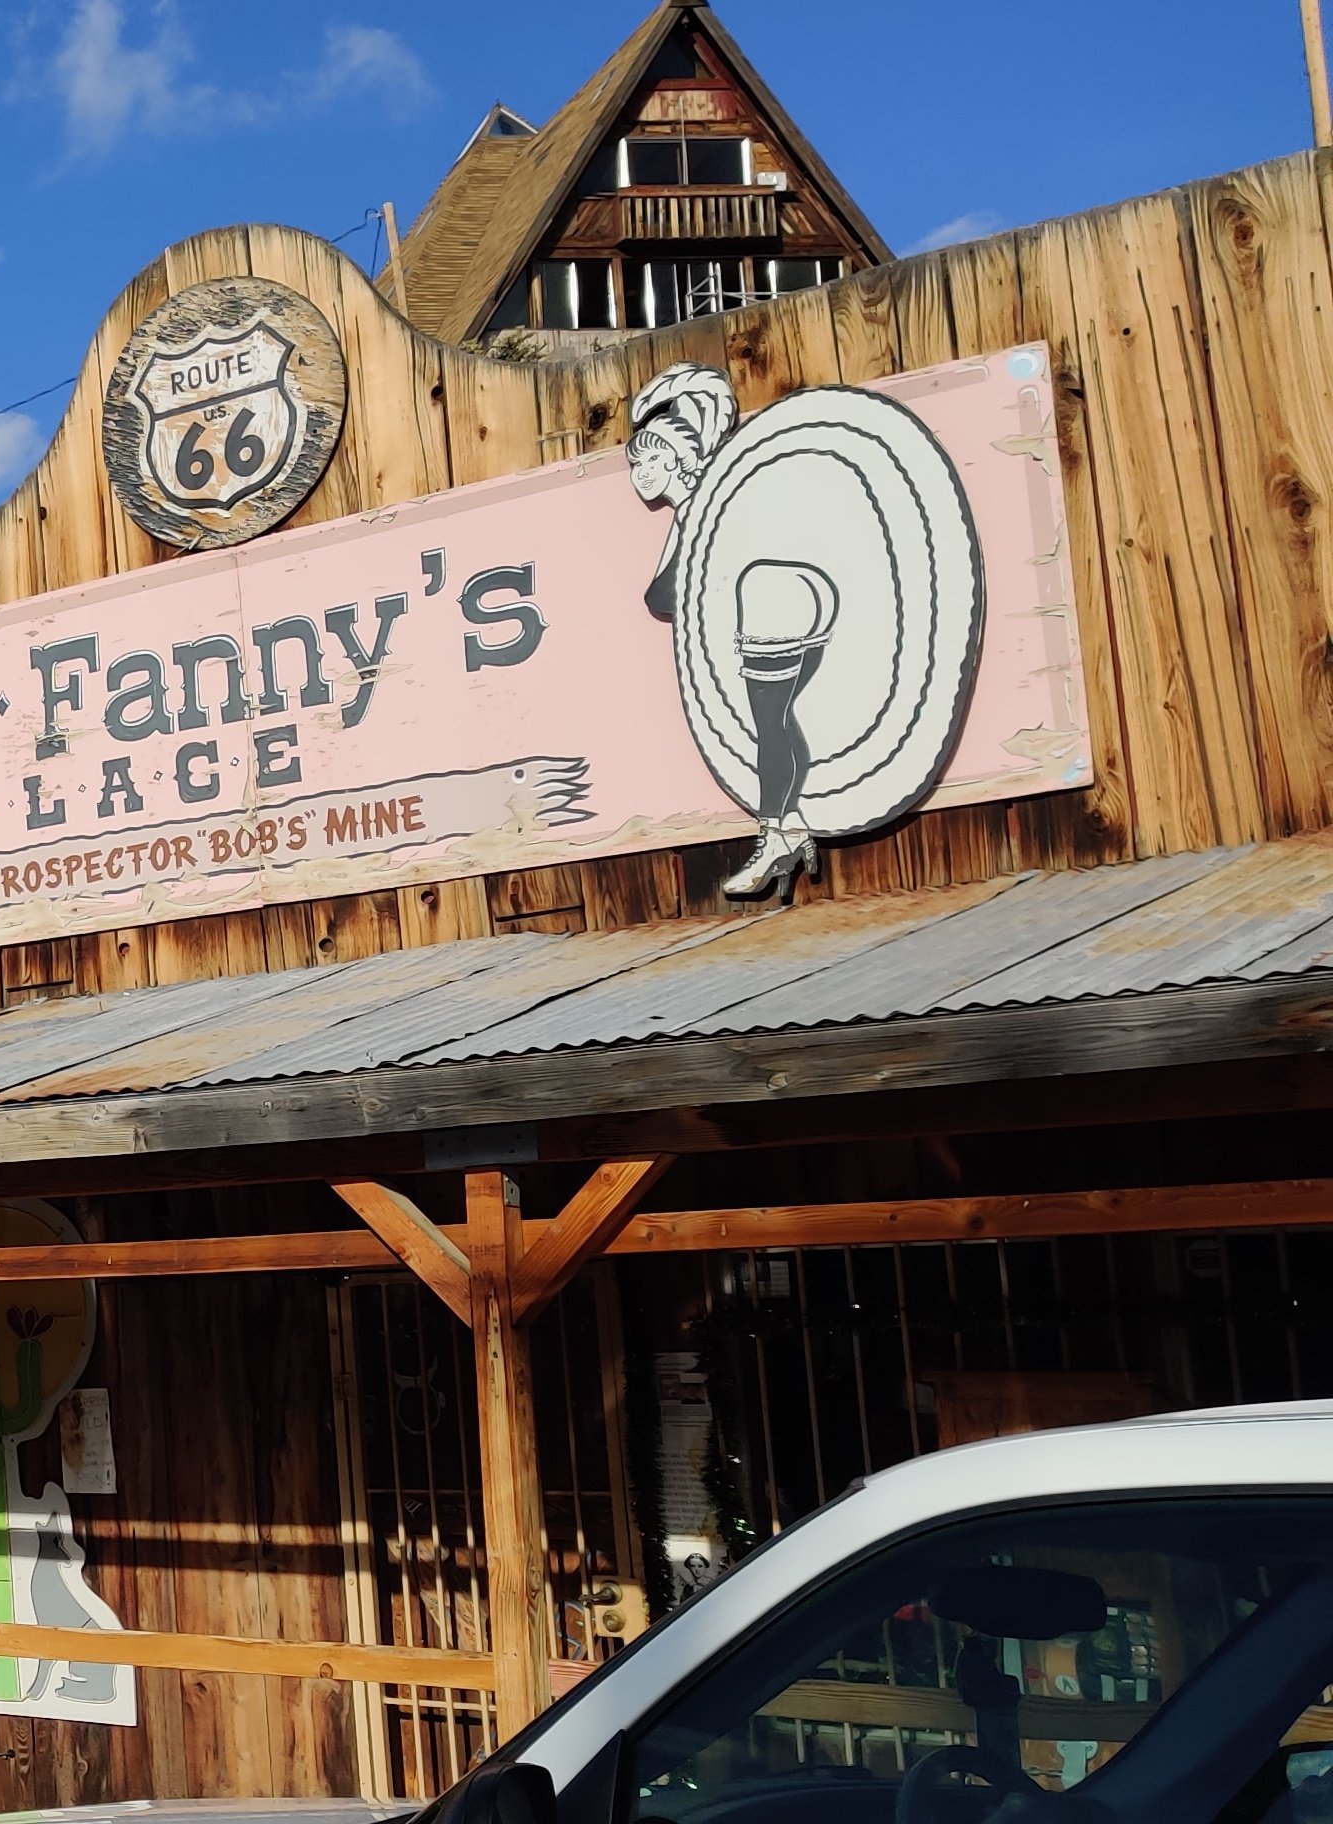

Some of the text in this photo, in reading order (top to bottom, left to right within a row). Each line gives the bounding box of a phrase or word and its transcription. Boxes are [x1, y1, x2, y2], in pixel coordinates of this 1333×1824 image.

[170, 350, 253, 395] ROUTE
[203, 405, 231, 423] U.S.
[175, 406, 266, 491] 66
[28, 546, 550, 762] Fanny's
[323, 794, 428, 846] MINE
